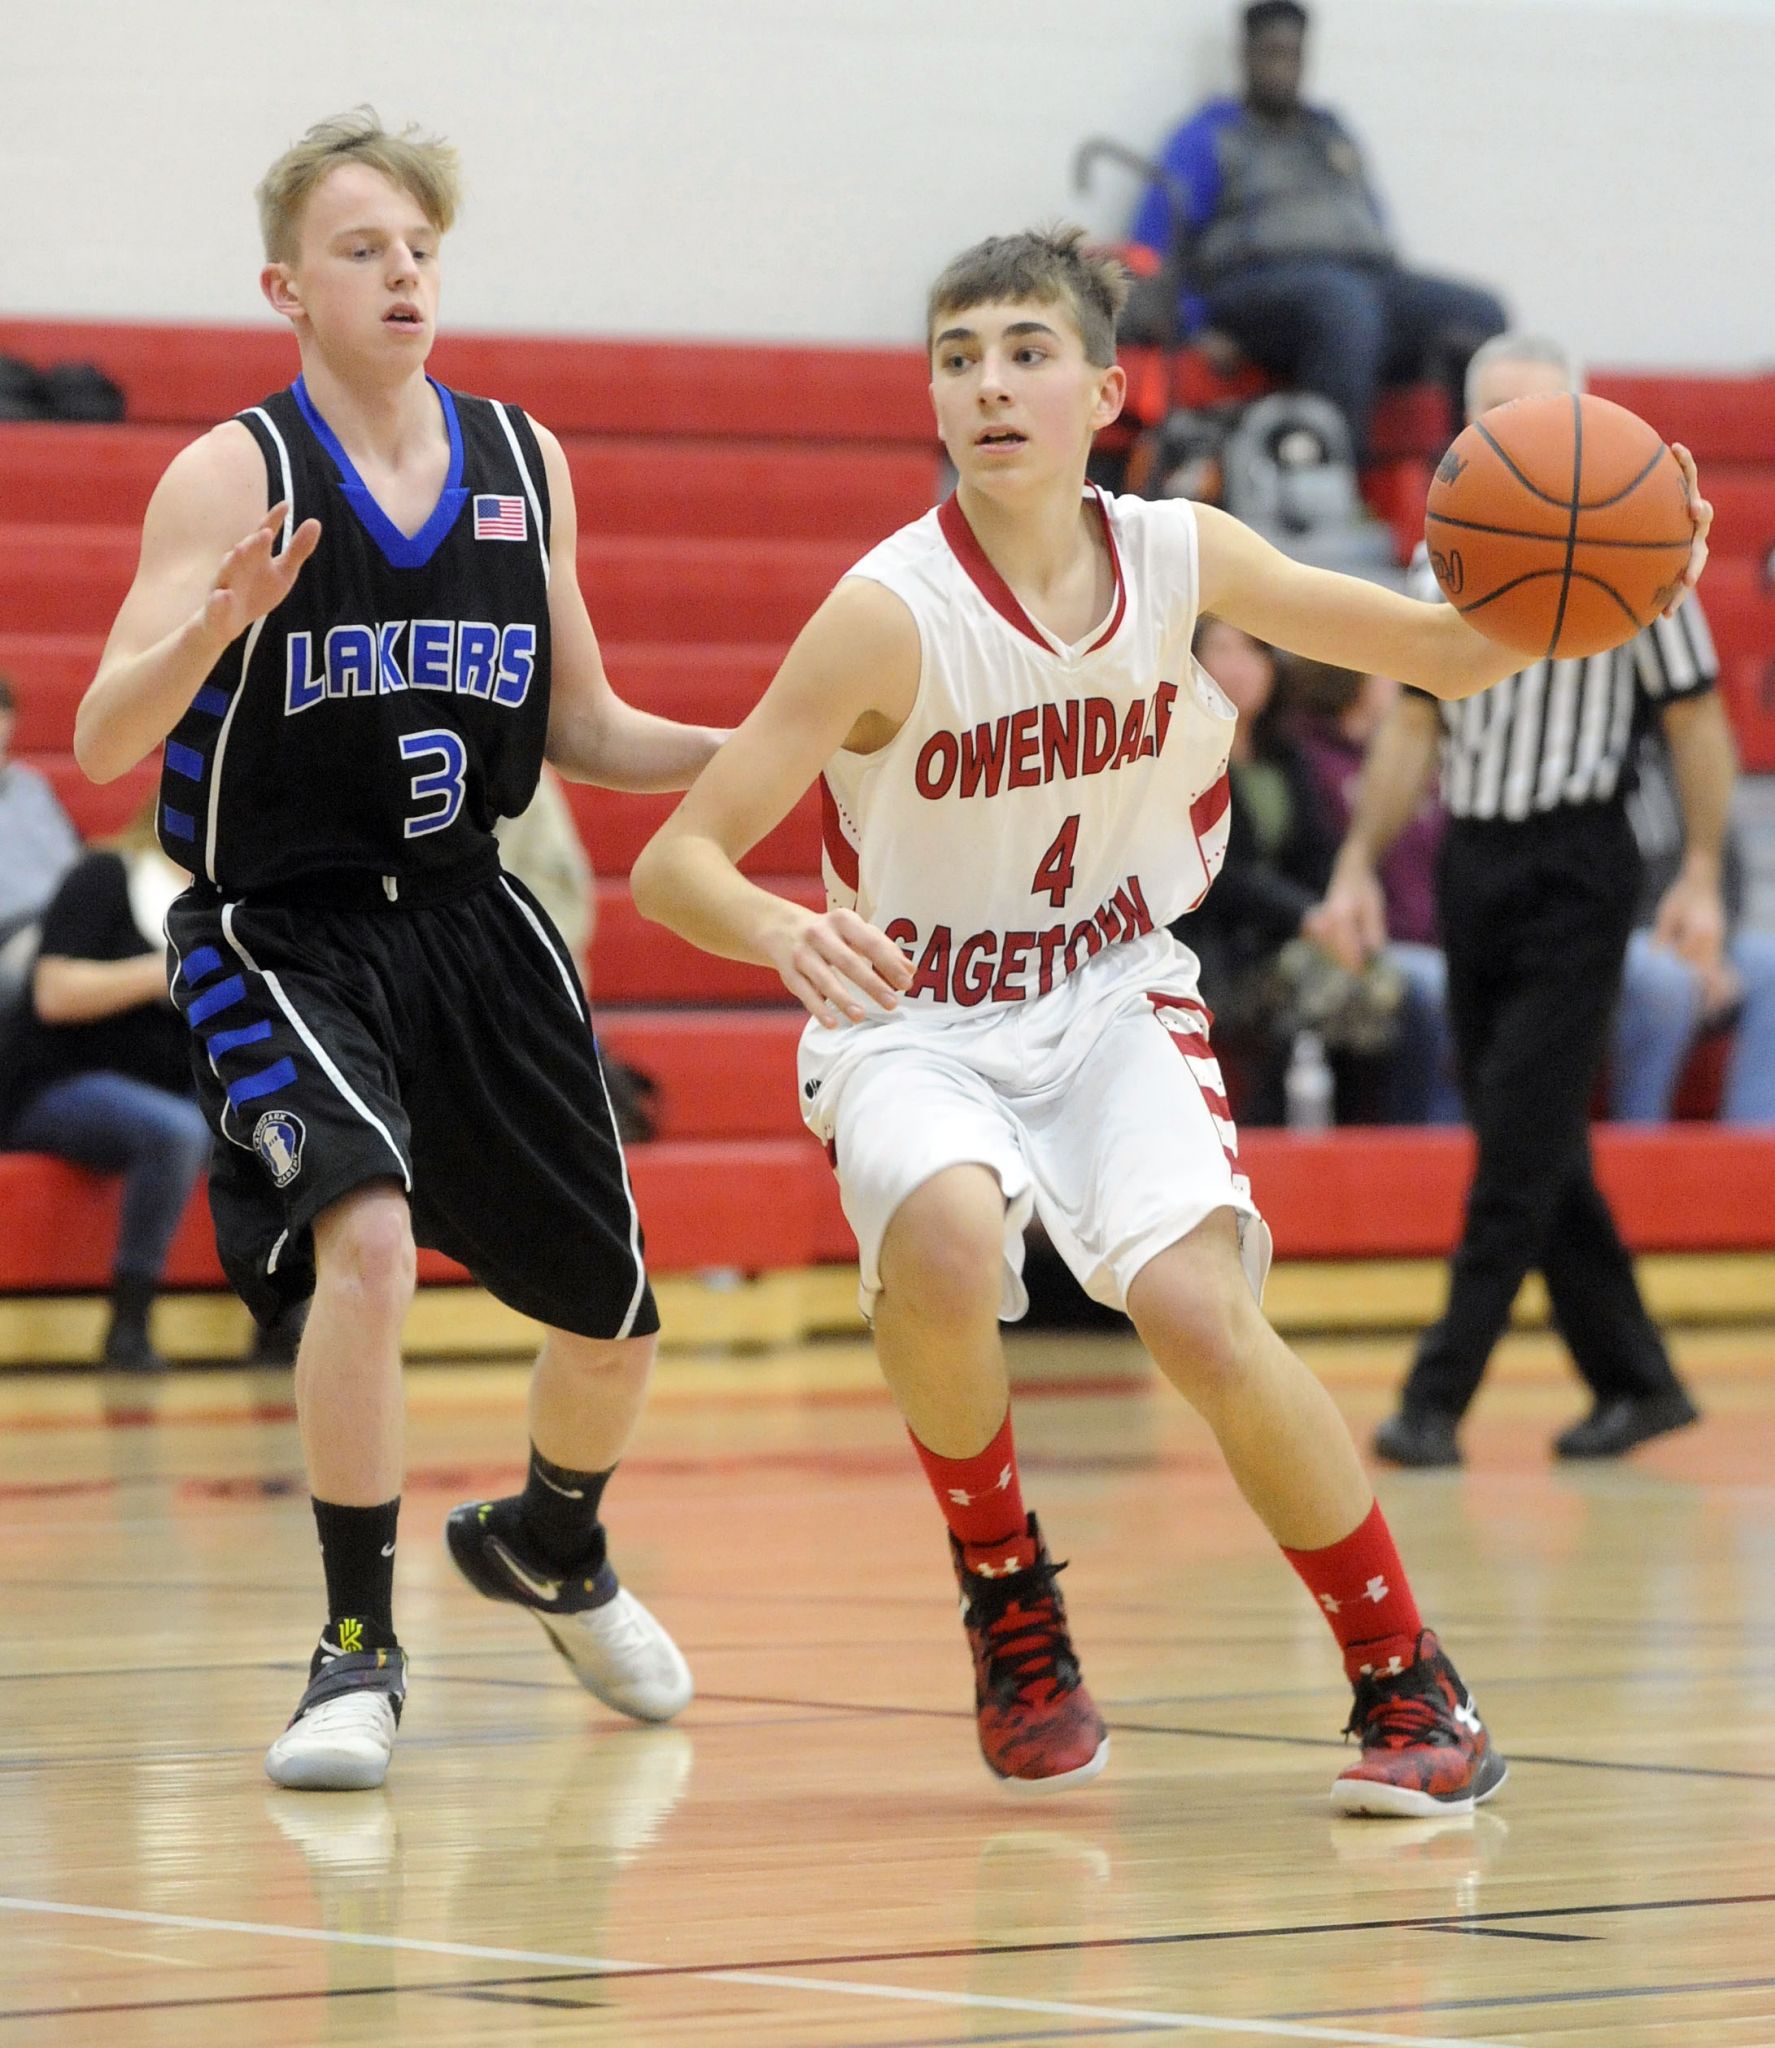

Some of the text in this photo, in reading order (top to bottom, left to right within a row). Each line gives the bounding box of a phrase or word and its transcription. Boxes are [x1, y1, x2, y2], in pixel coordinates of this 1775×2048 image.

[284, 619, 537, 717] LAKERS
[398, 728, 467, 839] 3
[1031, 813, 1081, 908] 4
